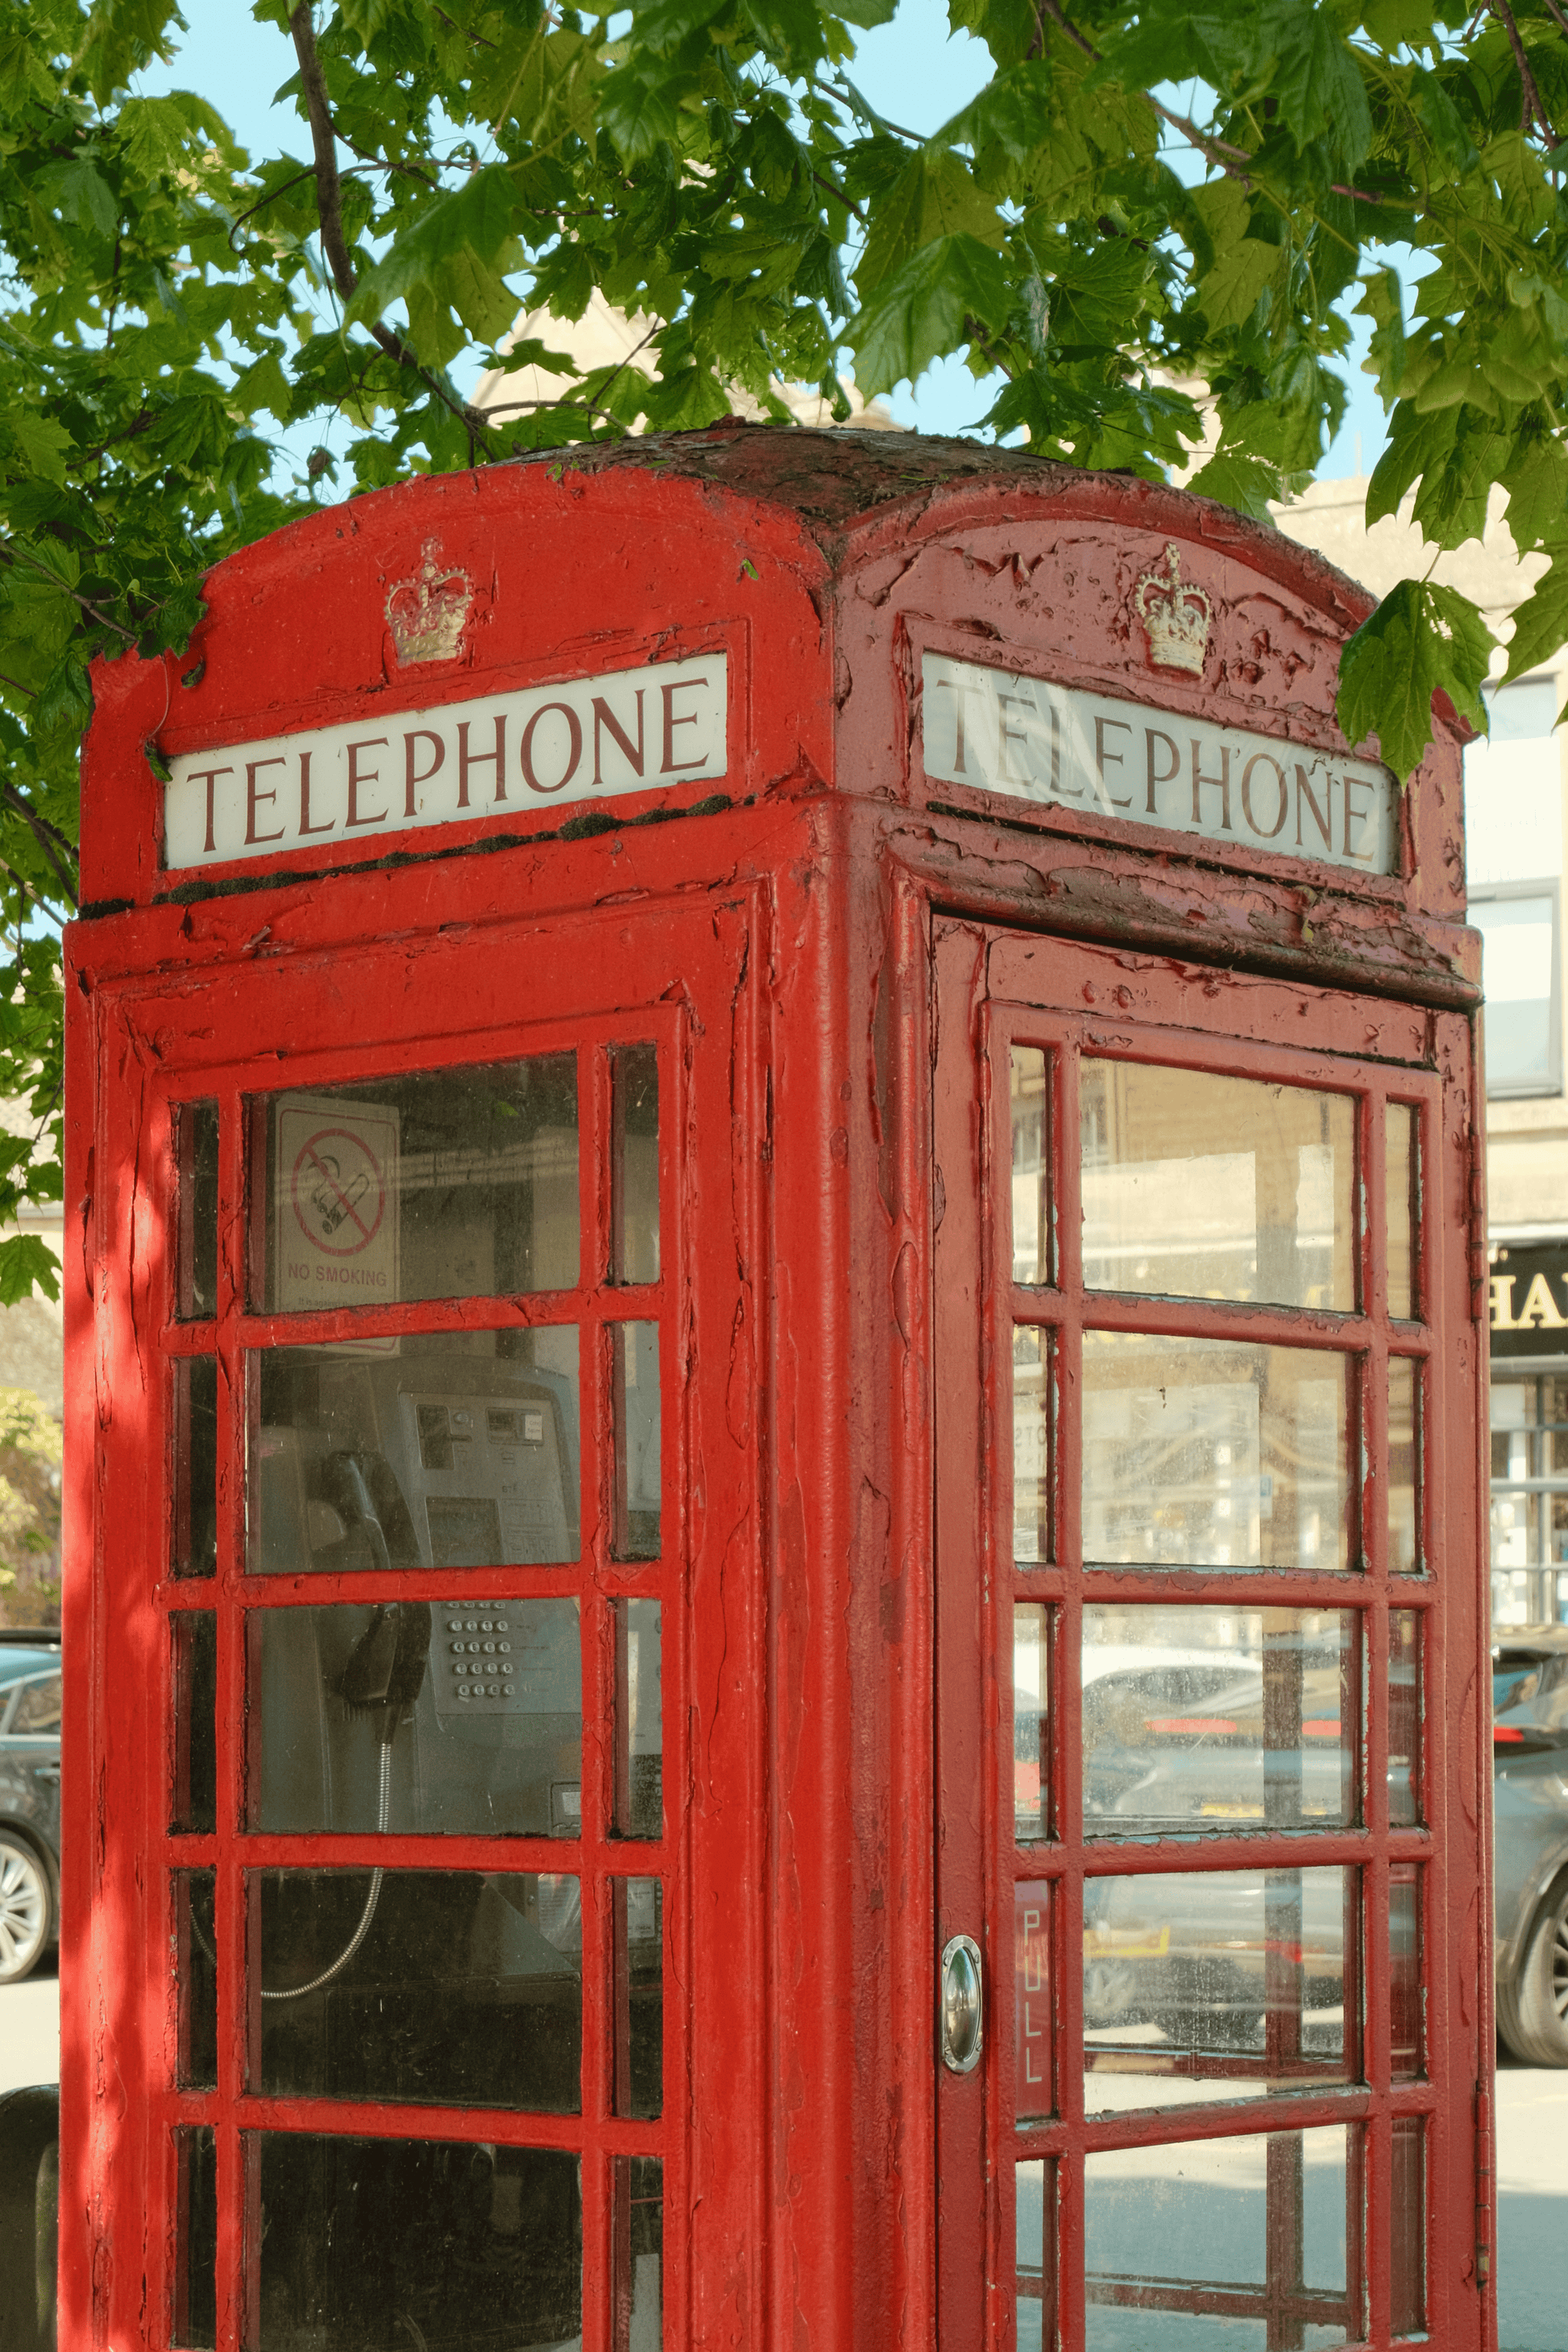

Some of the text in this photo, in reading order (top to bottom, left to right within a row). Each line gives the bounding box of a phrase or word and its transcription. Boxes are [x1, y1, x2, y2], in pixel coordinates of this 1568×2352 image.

[186, 678, 710, 852] TELEPHONE
[935, 678, 1378, 863] TELEPHONE
[288, 1262, 387, 1287] NO SMOKING
[1489, 1272, 1568, 1330] HA
[1024, 1909, 1043, 2084] PULL
